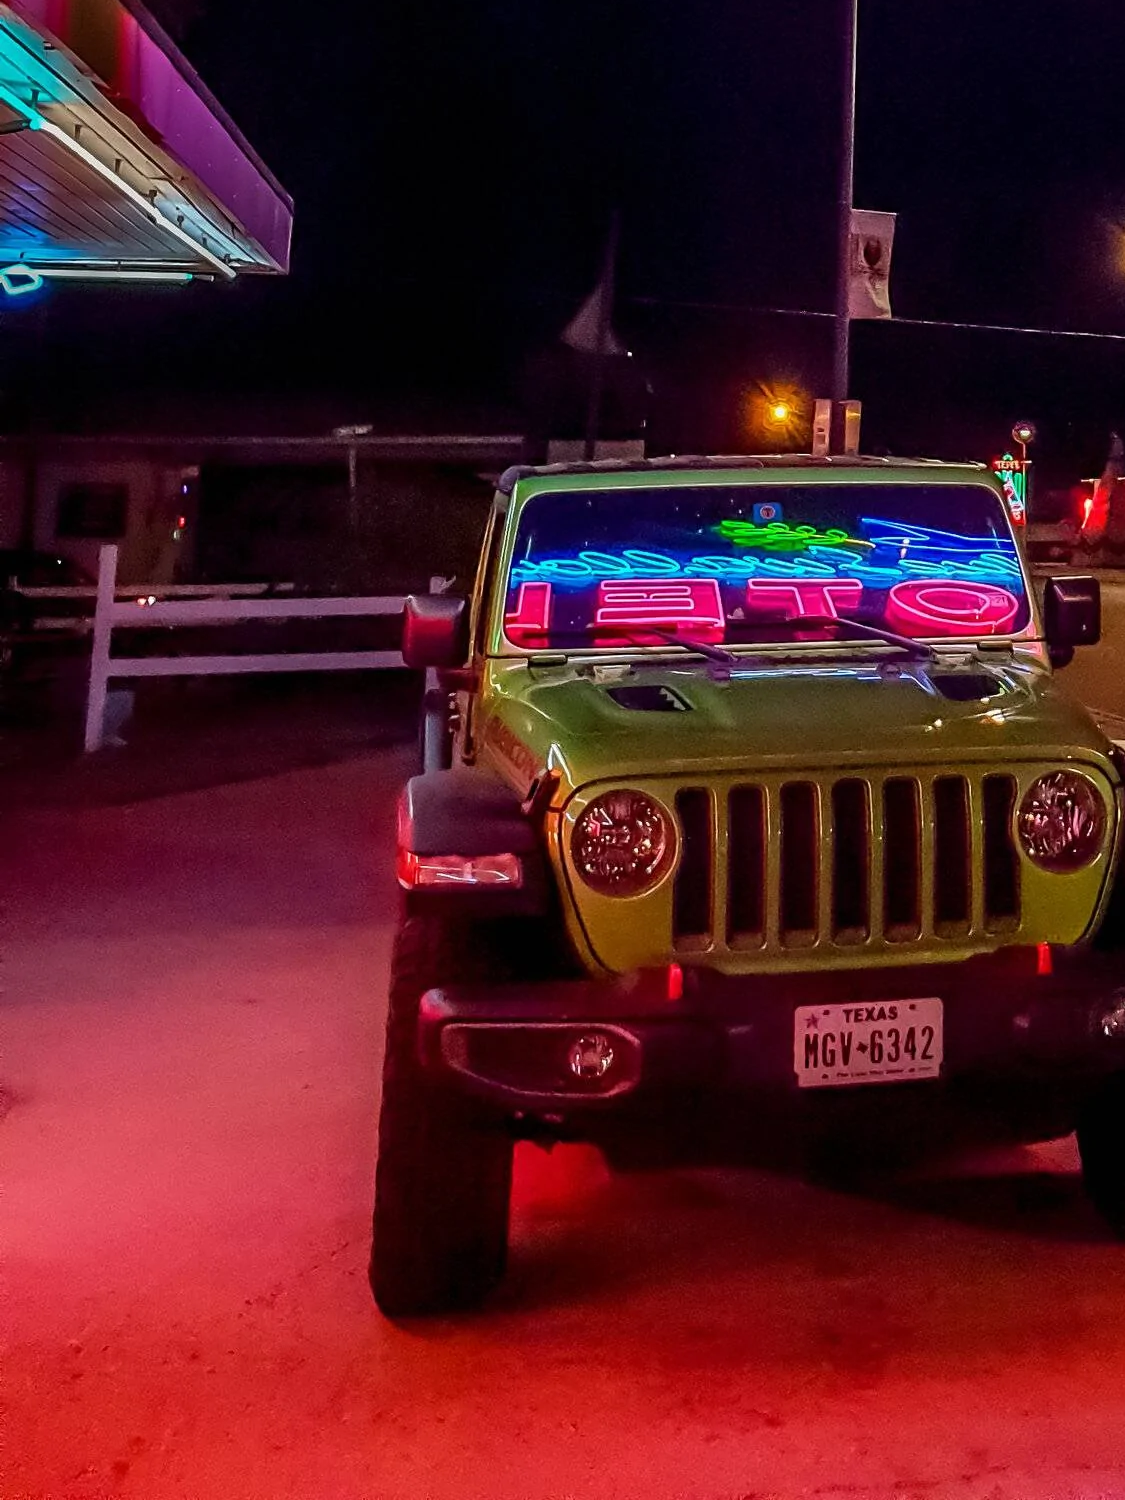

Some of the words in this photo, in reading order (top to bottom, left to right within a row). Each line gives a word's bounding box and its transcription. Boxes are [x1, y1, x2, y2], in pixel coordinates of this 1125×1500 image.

[843, 1006, 898, 1023] TEXAS
[804, 1031, 853, 1069] MGV
[870, 1025, 934, 1064] 6342
